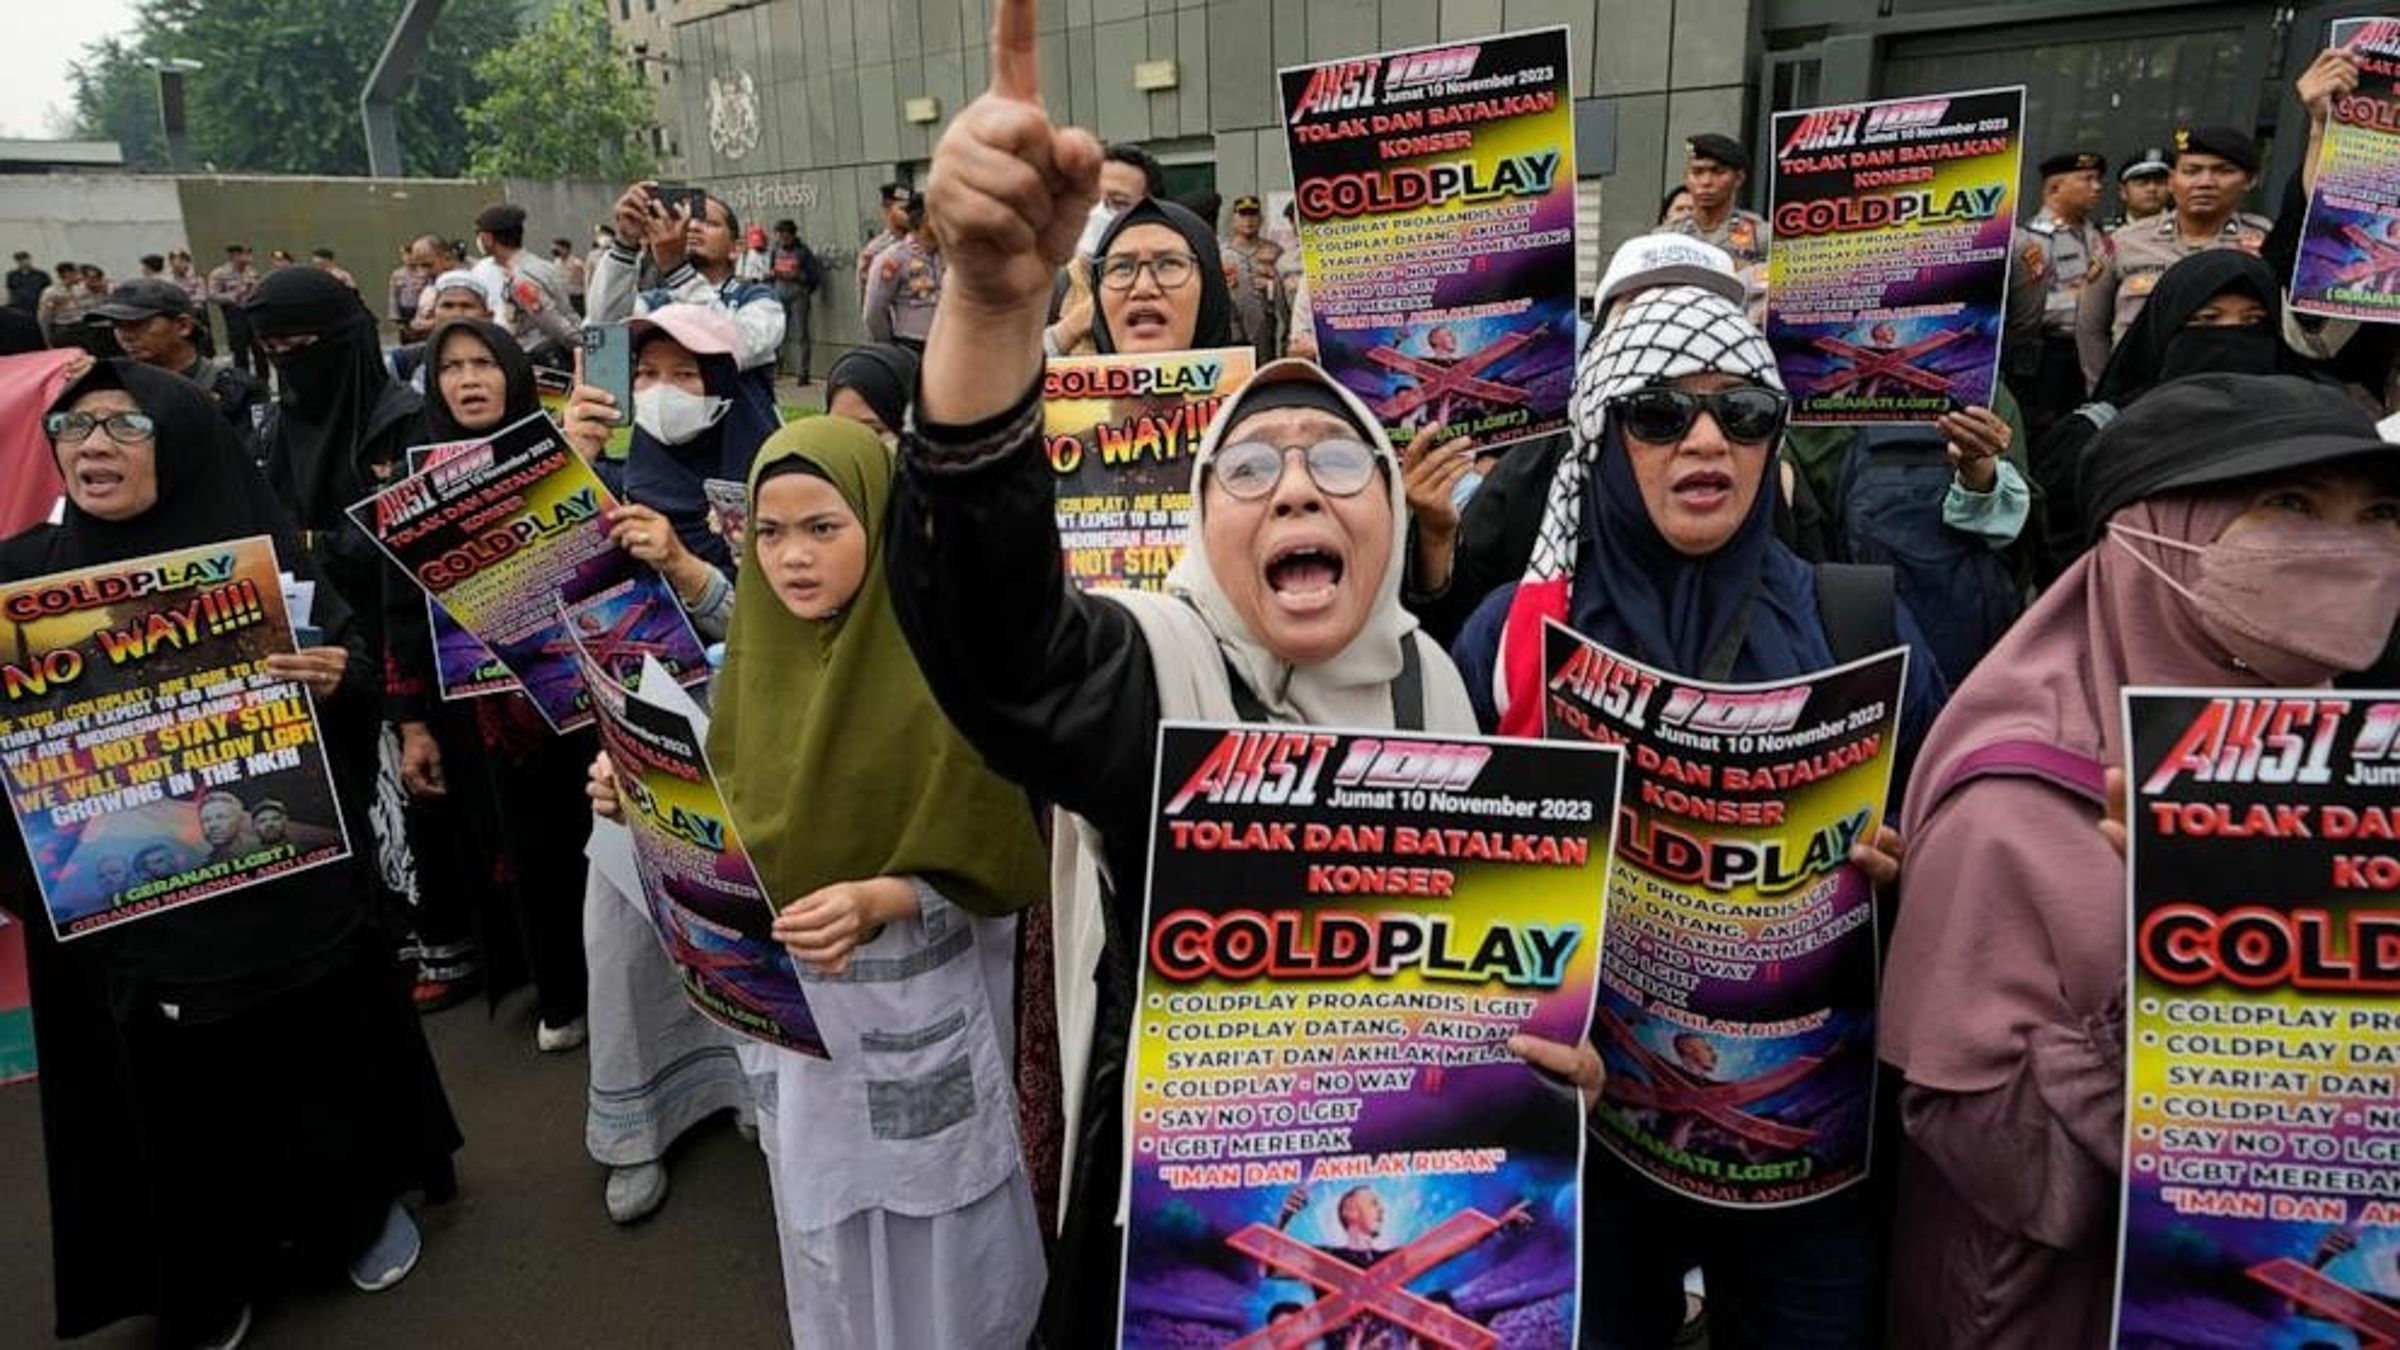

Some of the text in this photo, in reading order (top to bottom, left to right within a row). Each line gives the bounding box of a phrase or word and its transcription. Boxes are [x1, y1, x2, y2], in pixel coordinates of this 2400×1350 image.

[1382, 65, 1554, 105] Jumat 10 November 2023
[1294, 91, 1556, 144] TOLAK DAN BATALKAN
[1379, 130, 1473, 160] KONSER
[1780, 137, 2008, 175] TOLAK DAN BATALKAN
[1299, 151, 1559, 219] COLDPLAY
[1853, 166, 1936, 189] KONSER
[1775, 186, 2004, 237] COLDPLAY
[1044, 361, 1220, 398] COLDPLAY
[418, 488, 600, 589] COLDPLAY
[1070, 547, 1115, 577] NOT
[6, 550, 235, 622] COLDPLAY
[1, 648, 83, 701] NO
[1549, 640, 1662, 731] AKSI
[11, 697, 309, 790] WILL NOT STAY STILL
[1655, 701, 1886, 755] Jumat 10 November 2023
[2141, 697, 2351, 795] AKSI
[64, 770, 118, 801] WILL
[127, 755, 174, 785] NOT
[182, 737, 254, 773] ALLOW
[261, 720, 316, 752] LGBT
[1164, 730, 1338, 815] AKSI
[1636, 732, 1882, 793] DAN BATALKAN
[2345, 761, 2400, 787] Jum
[50, 746, 301, 826] GROWING IN THE NKRI
[1327, 786, 1594, 821] Jumat 10 November 2023
[1641, 780, 1786, 827] KONSER
[2150, 801, 2400, 839] TOLAK DA
[1170, 819, 1589, 868] TOLAK DAN BATALKAN
[1618, 805, 1874, 895] LDPLAY
[1306, 864, 1456, 897] KONSER
[1646, 881, 1799, 919] PROAGANDIS
[1149, 906, 1582, 989] COLDPLAY
[1653, 943, 1758, 981] NO WAY
[1680, 930, 1780, 961] AKHLAK
[2138, 902, 2400, 992] COLD
[1168, 992, 1535, 1018] COLDPLAY PROAGANDIS LGBT
[2164, 1001, 2339, 1030] COLDPLAY
[1165, 1020, 1297, 1043] COLDPLAY
[1304, 1018, 1409, 1038] DATANG,
[2164, 1032, 2337, 1062] COLDPLAY
[1166, 1044, 1437, 1071] SYARI'AT DAN AKHLAK
[1160, 1069, 1414, 1099] COLDPLAY NO WAY
[2167, 1064, 2394, 1097] SYARI'AT DAN
[1159, 1099, 1361, 1130] SAY NO TO LGBT
[2162, 1095, 2339, 1127] COLDPLAY
[1158, 1129, 1352, 1159] LGBT MEREBAK
[2162, 1127, 2400, 1165] SAY NO TO LGB
[1244, 1160, 1299, 1186] DAN
[1308, 1153, 1410, 1181] AKHLAK
[2158, 1156, 2246, 1185] LGBT
[2270, 1194, 2348, 1223] DAN
